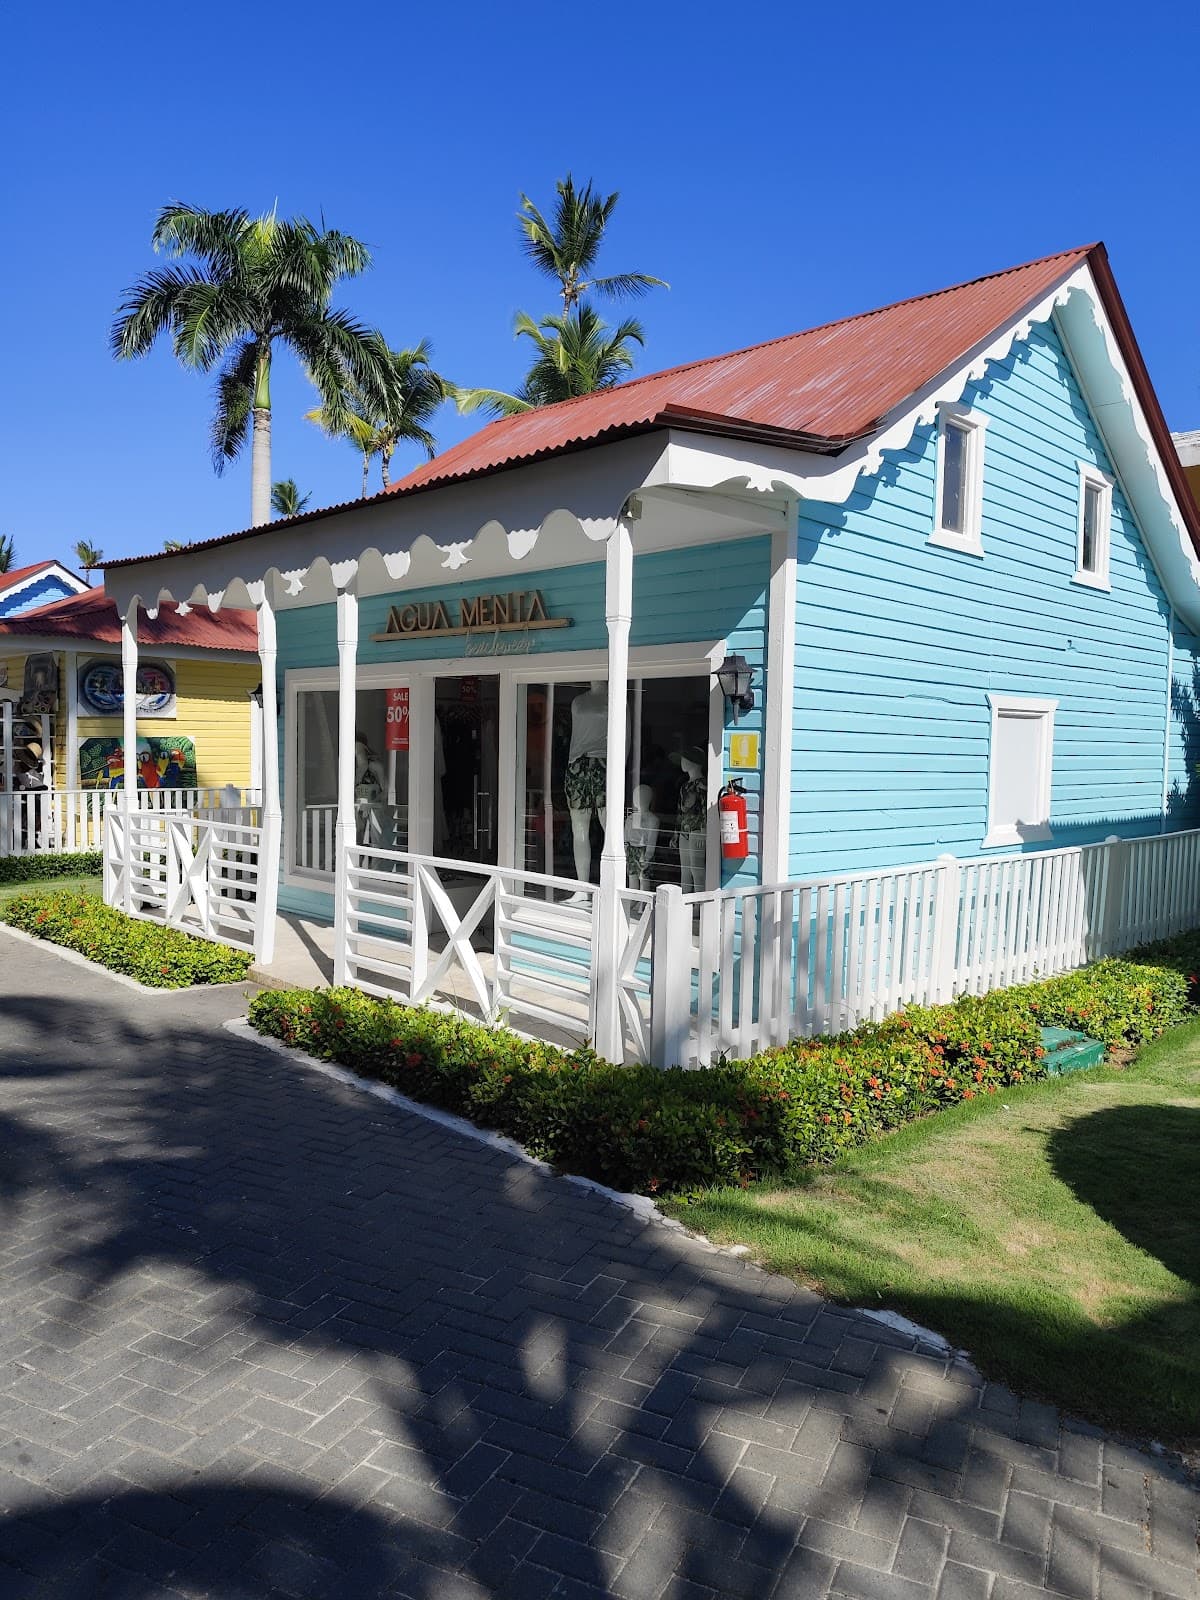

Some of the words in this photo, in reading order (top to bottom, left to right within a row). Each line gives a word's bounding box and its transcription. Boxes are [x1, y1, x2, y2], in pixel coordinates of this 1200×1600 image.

[385, 601, 449, 633] AGUA
[460, 590, 547, 627] MENTA
[392, 692, 409, 702] SALE
